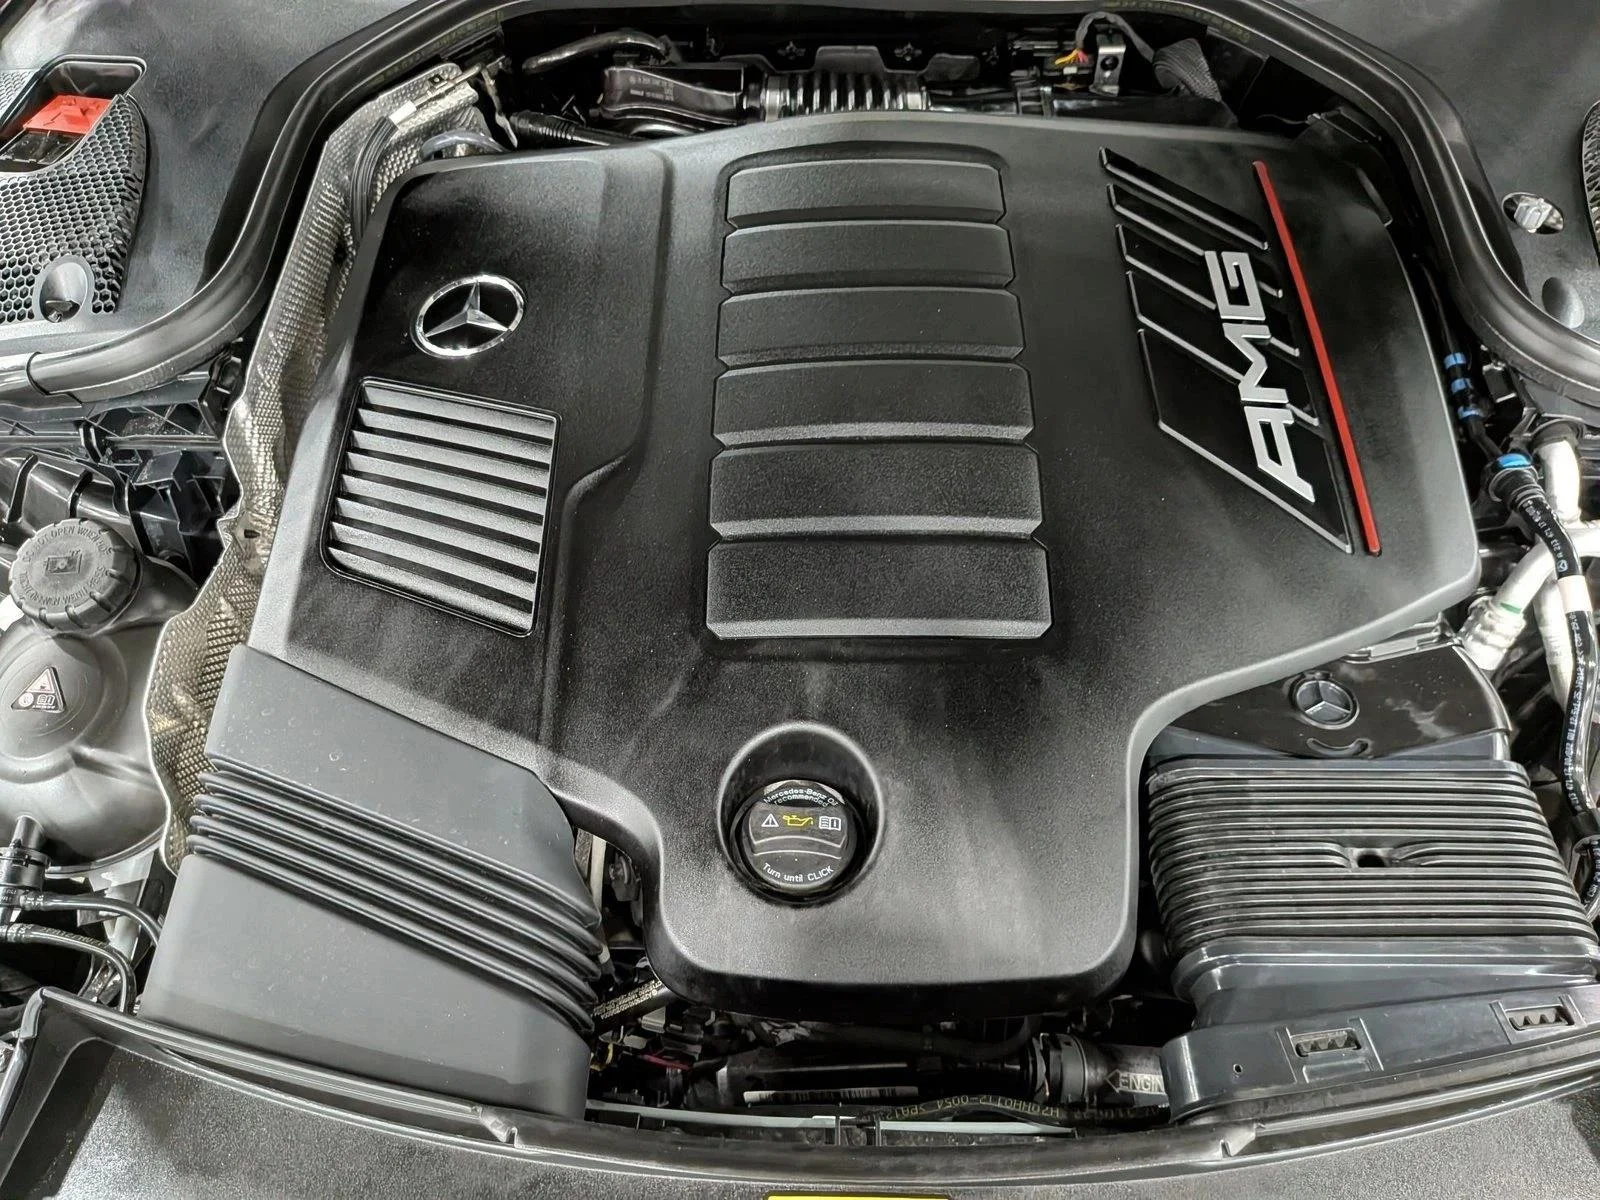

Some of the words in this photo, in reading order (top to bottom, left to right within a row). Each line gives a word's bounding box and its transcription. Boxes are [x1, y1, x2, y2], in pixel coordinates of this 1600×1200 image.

[1204, 250, 1316, 502] AMG
[51, 525, 76, 538] OPEN
[77, 526, 100, 544] WHEN
[763, 788, 827, 803] Mercedes-Benz
[774, 794, 829, 807] recommended
[762, 862, 781, 878] Turn
[783, 874, 804, 882] until
[807, 865, 834, 881] CLICK
